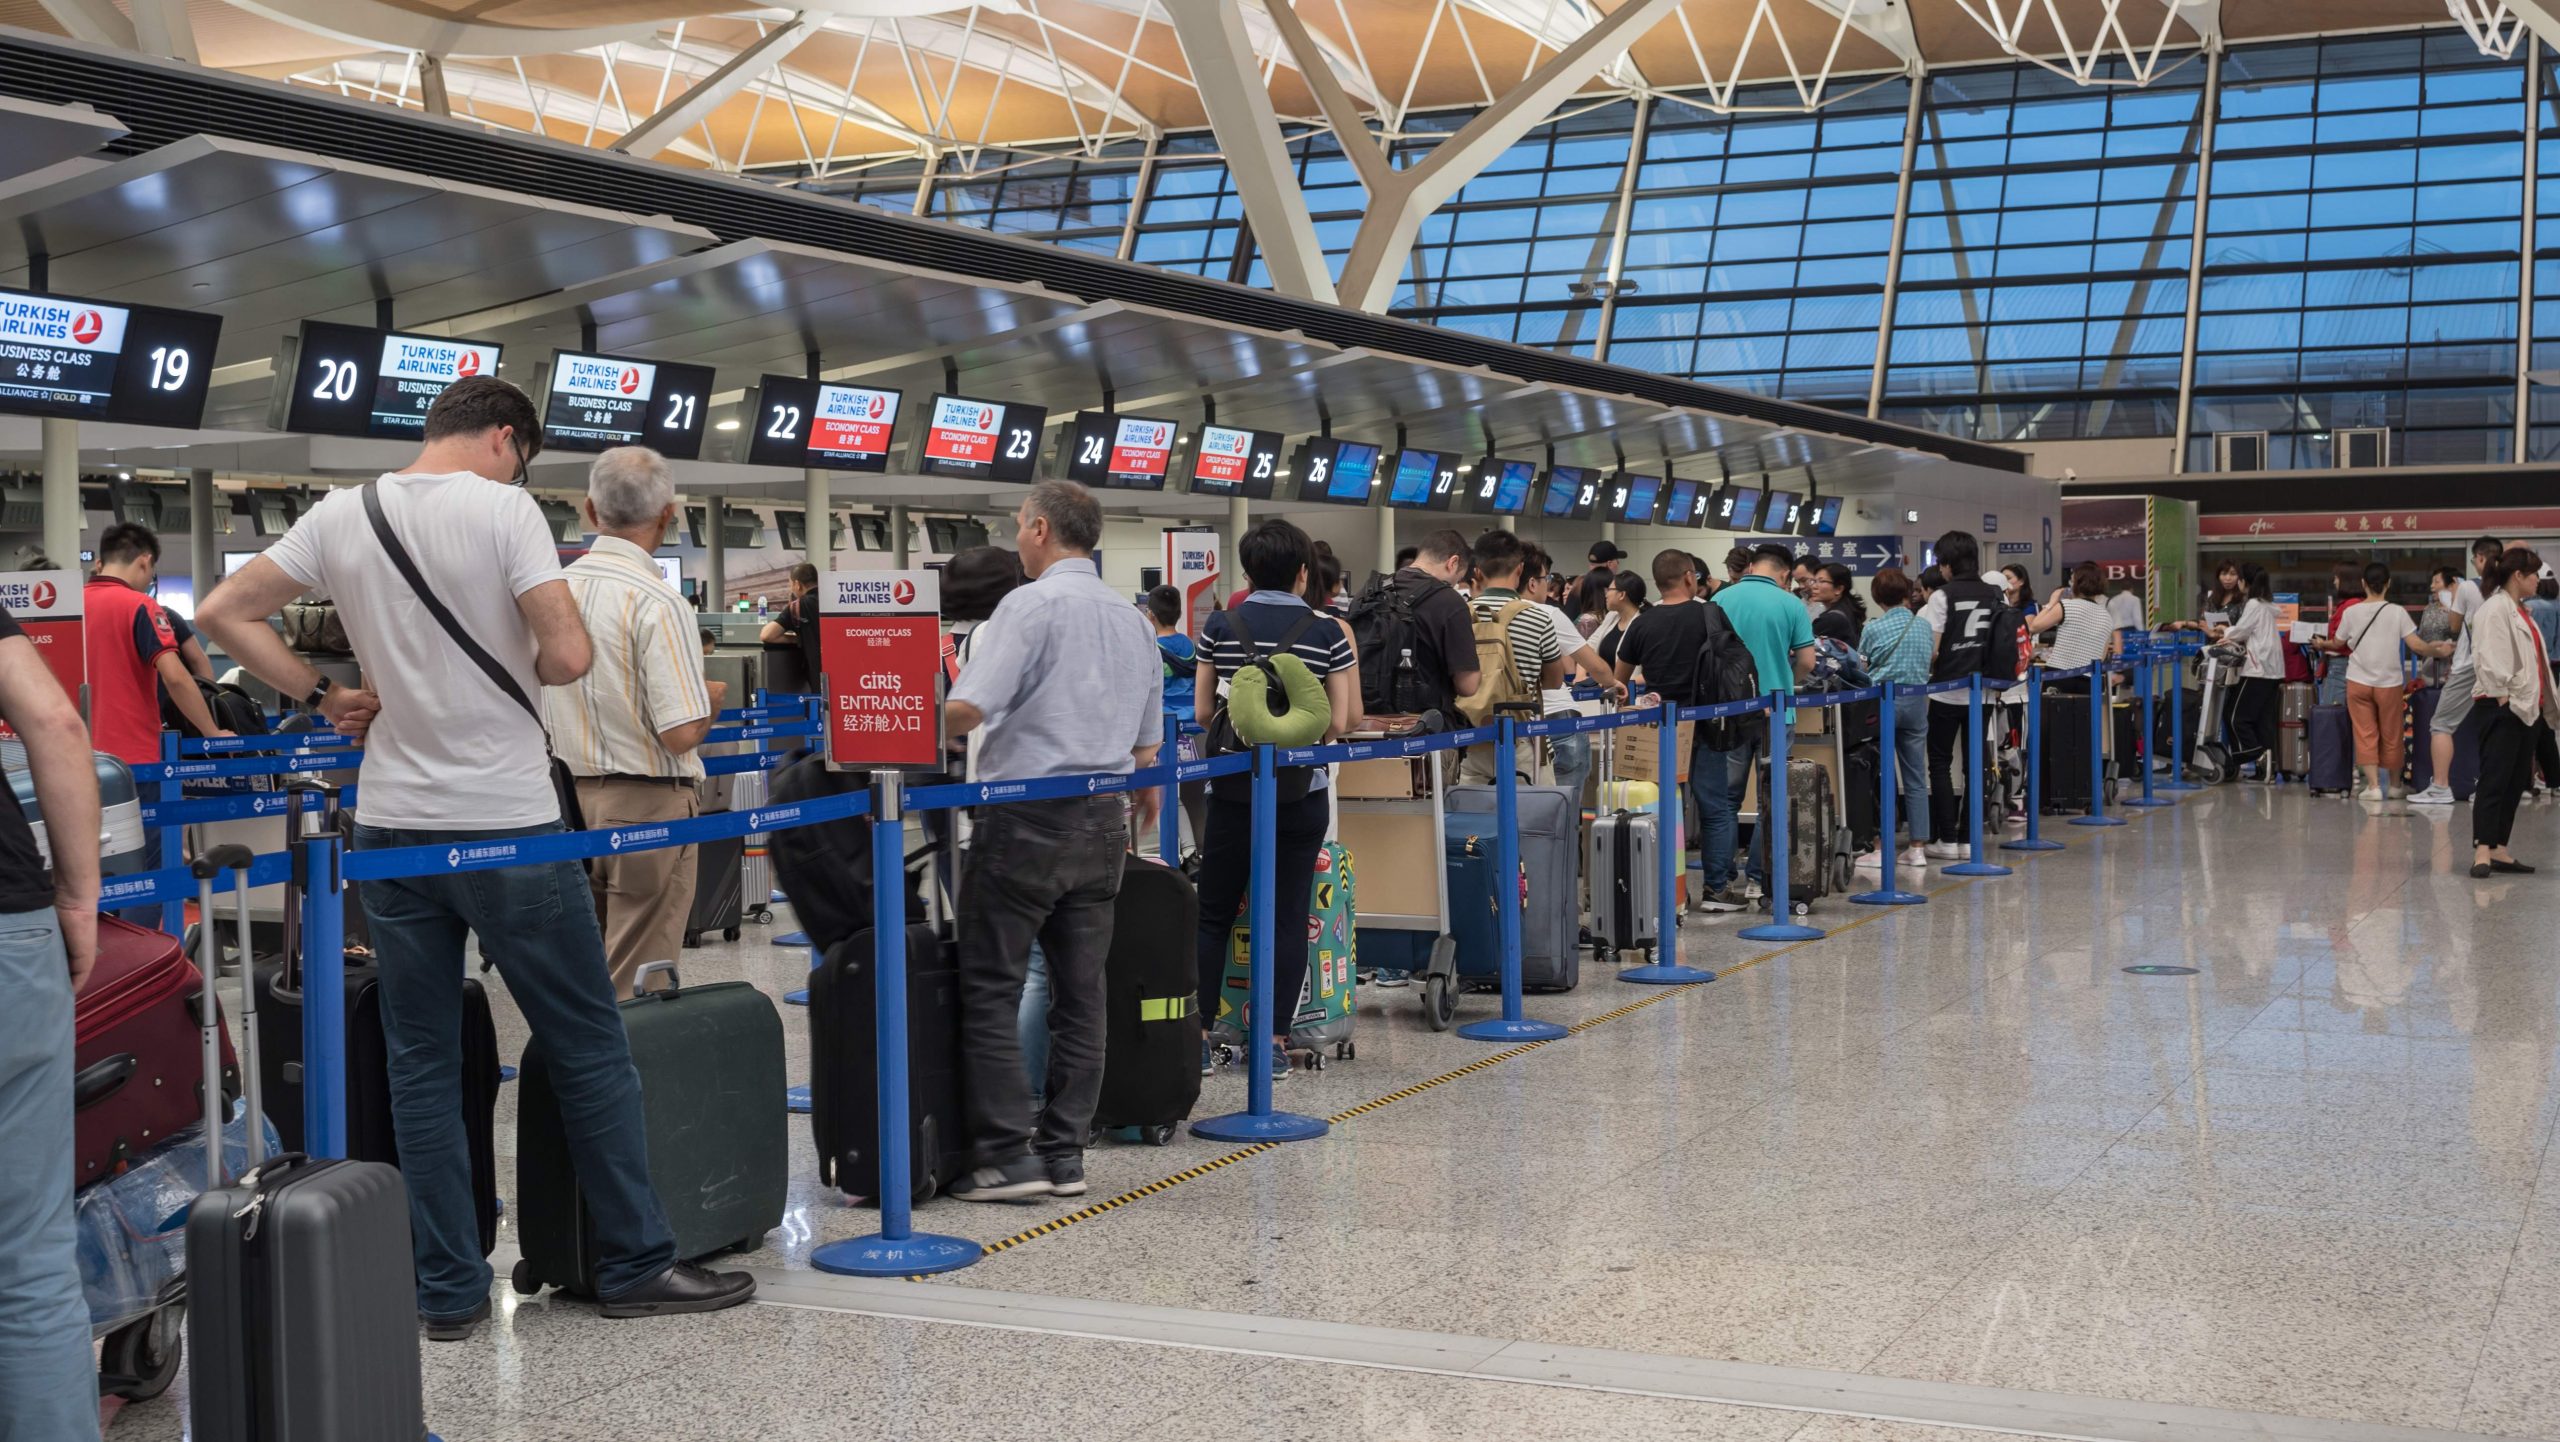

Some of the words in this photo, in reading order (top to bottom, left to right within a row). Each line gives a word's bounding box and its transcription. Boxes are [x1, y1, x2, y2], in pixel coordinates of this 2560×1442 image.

[53, 351, 92, 366] CLASS
[401, 344, 456, 361] TURKISH
[151, 346, 190, 391] 19
[397, 359, 453, 375] AIRLINES
[572, 362, 619, 378] TURKISH
[313, 358, 358, 401] 20
[568, 376, 617, 391] AIRLINES
[397, 380, 442, 395] BUSINESS
[53, 394, 76, 402] GOLD
[568, 395, 607, 410] BUSINESS
[607, 399, 632, 411] CLASS
[831, 392, 869, 404] TURKISH
[663, 393, 696, 430] 21
[827, 403, 867, 416] AIRLINES
[946, 403, 979, 416] TURKISH
[383, 416, 400, 424] STAR
[400, 417, 426, 427] ALLIAN
[767, 405, 799, 439] 22
[825, 421, 860, 433] ECONOMY
[860, 424, 880, 434] CLASS
[943, 414, 977, 427] AIRLINES
[570, 430, 598, 439] ALLIANCE
[1126, 424, 1154, 434] TURKISH
[940, 431, 970, 443] ECONOMY
[970, 435, 988, 444] CLASS
[1006, 429, 1032, 459] 23
[1123, 433, 1152, 444] AIRLINES
[1211, 432, 1235, 443] TURKISH
[1080, 436, 1105, 465] 24
[1208, 440, 1233, 451] AIRLINES
[1253, 453, 1273, 479] 25
[1308, 457, 1329, 483] 26
[1435, 470, 1453, 494] 27
[1480, 475, 1496, 498] 28
[1579, 484, 1594, 506] 29
[1612, 487, 1627, 508] 30
[1694, 495, 1706, 515] 31
[1720, 498, 1733, 517] 32
[2043, 516, 2052, 575] B
[1182, 551, 1204, 560] TURKISH
[1182, 561, 1205, 570] AIRLINES
[0, 584, 29, 596] KISH
[838, 581, 890, 592] TURKISH
[838, 593, 891, 604] AIRLINES
[30, 635, 53, 644] LASS
[846, 628, 886, 637] ECONOMY
[887, 628, 912, 637] CLASS
[867, 637, 891, 647] 经济舱
[859, 671, 902, 693] GİRİŞ
[840, 695, 924, 711] ENTRANCE
[843, 714, 920, 732] 经济舱入口
[622, 827, 669, 842] 上海浦东国际机场
[461, 844, 517, 860] 上海浦东国际机场
[99, 879, 155, 898] 东国际机场
